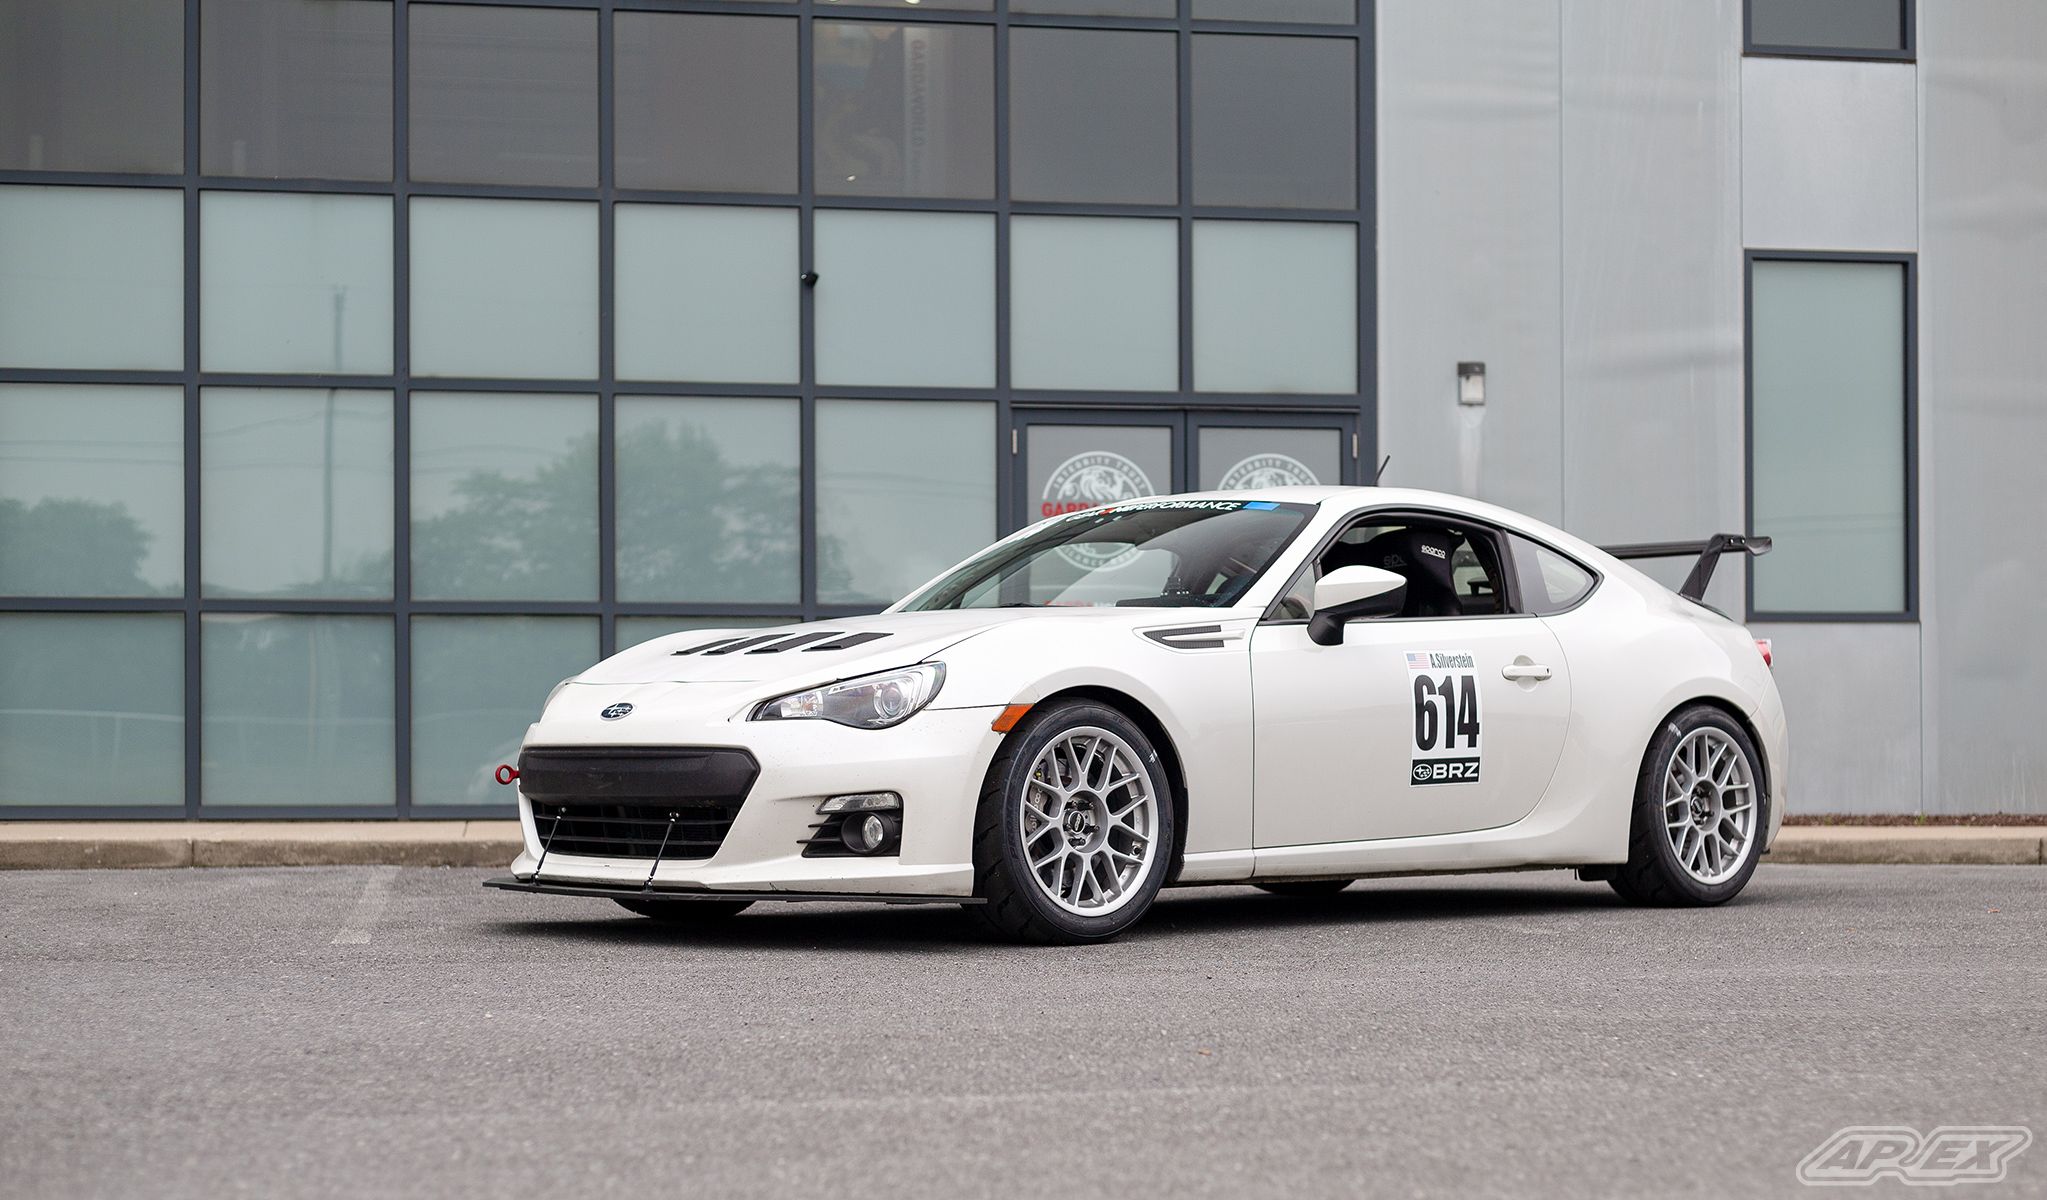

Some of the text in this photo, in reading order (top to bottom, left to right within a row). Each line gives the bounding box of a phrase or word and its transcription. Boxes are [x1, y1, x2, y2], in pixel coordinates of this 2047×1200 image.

[1429, 652, 1474, 669] A.Silverstein
[1414, 674, 1480, 751] 614
[1433, 762, 1479, 780] BRZ
